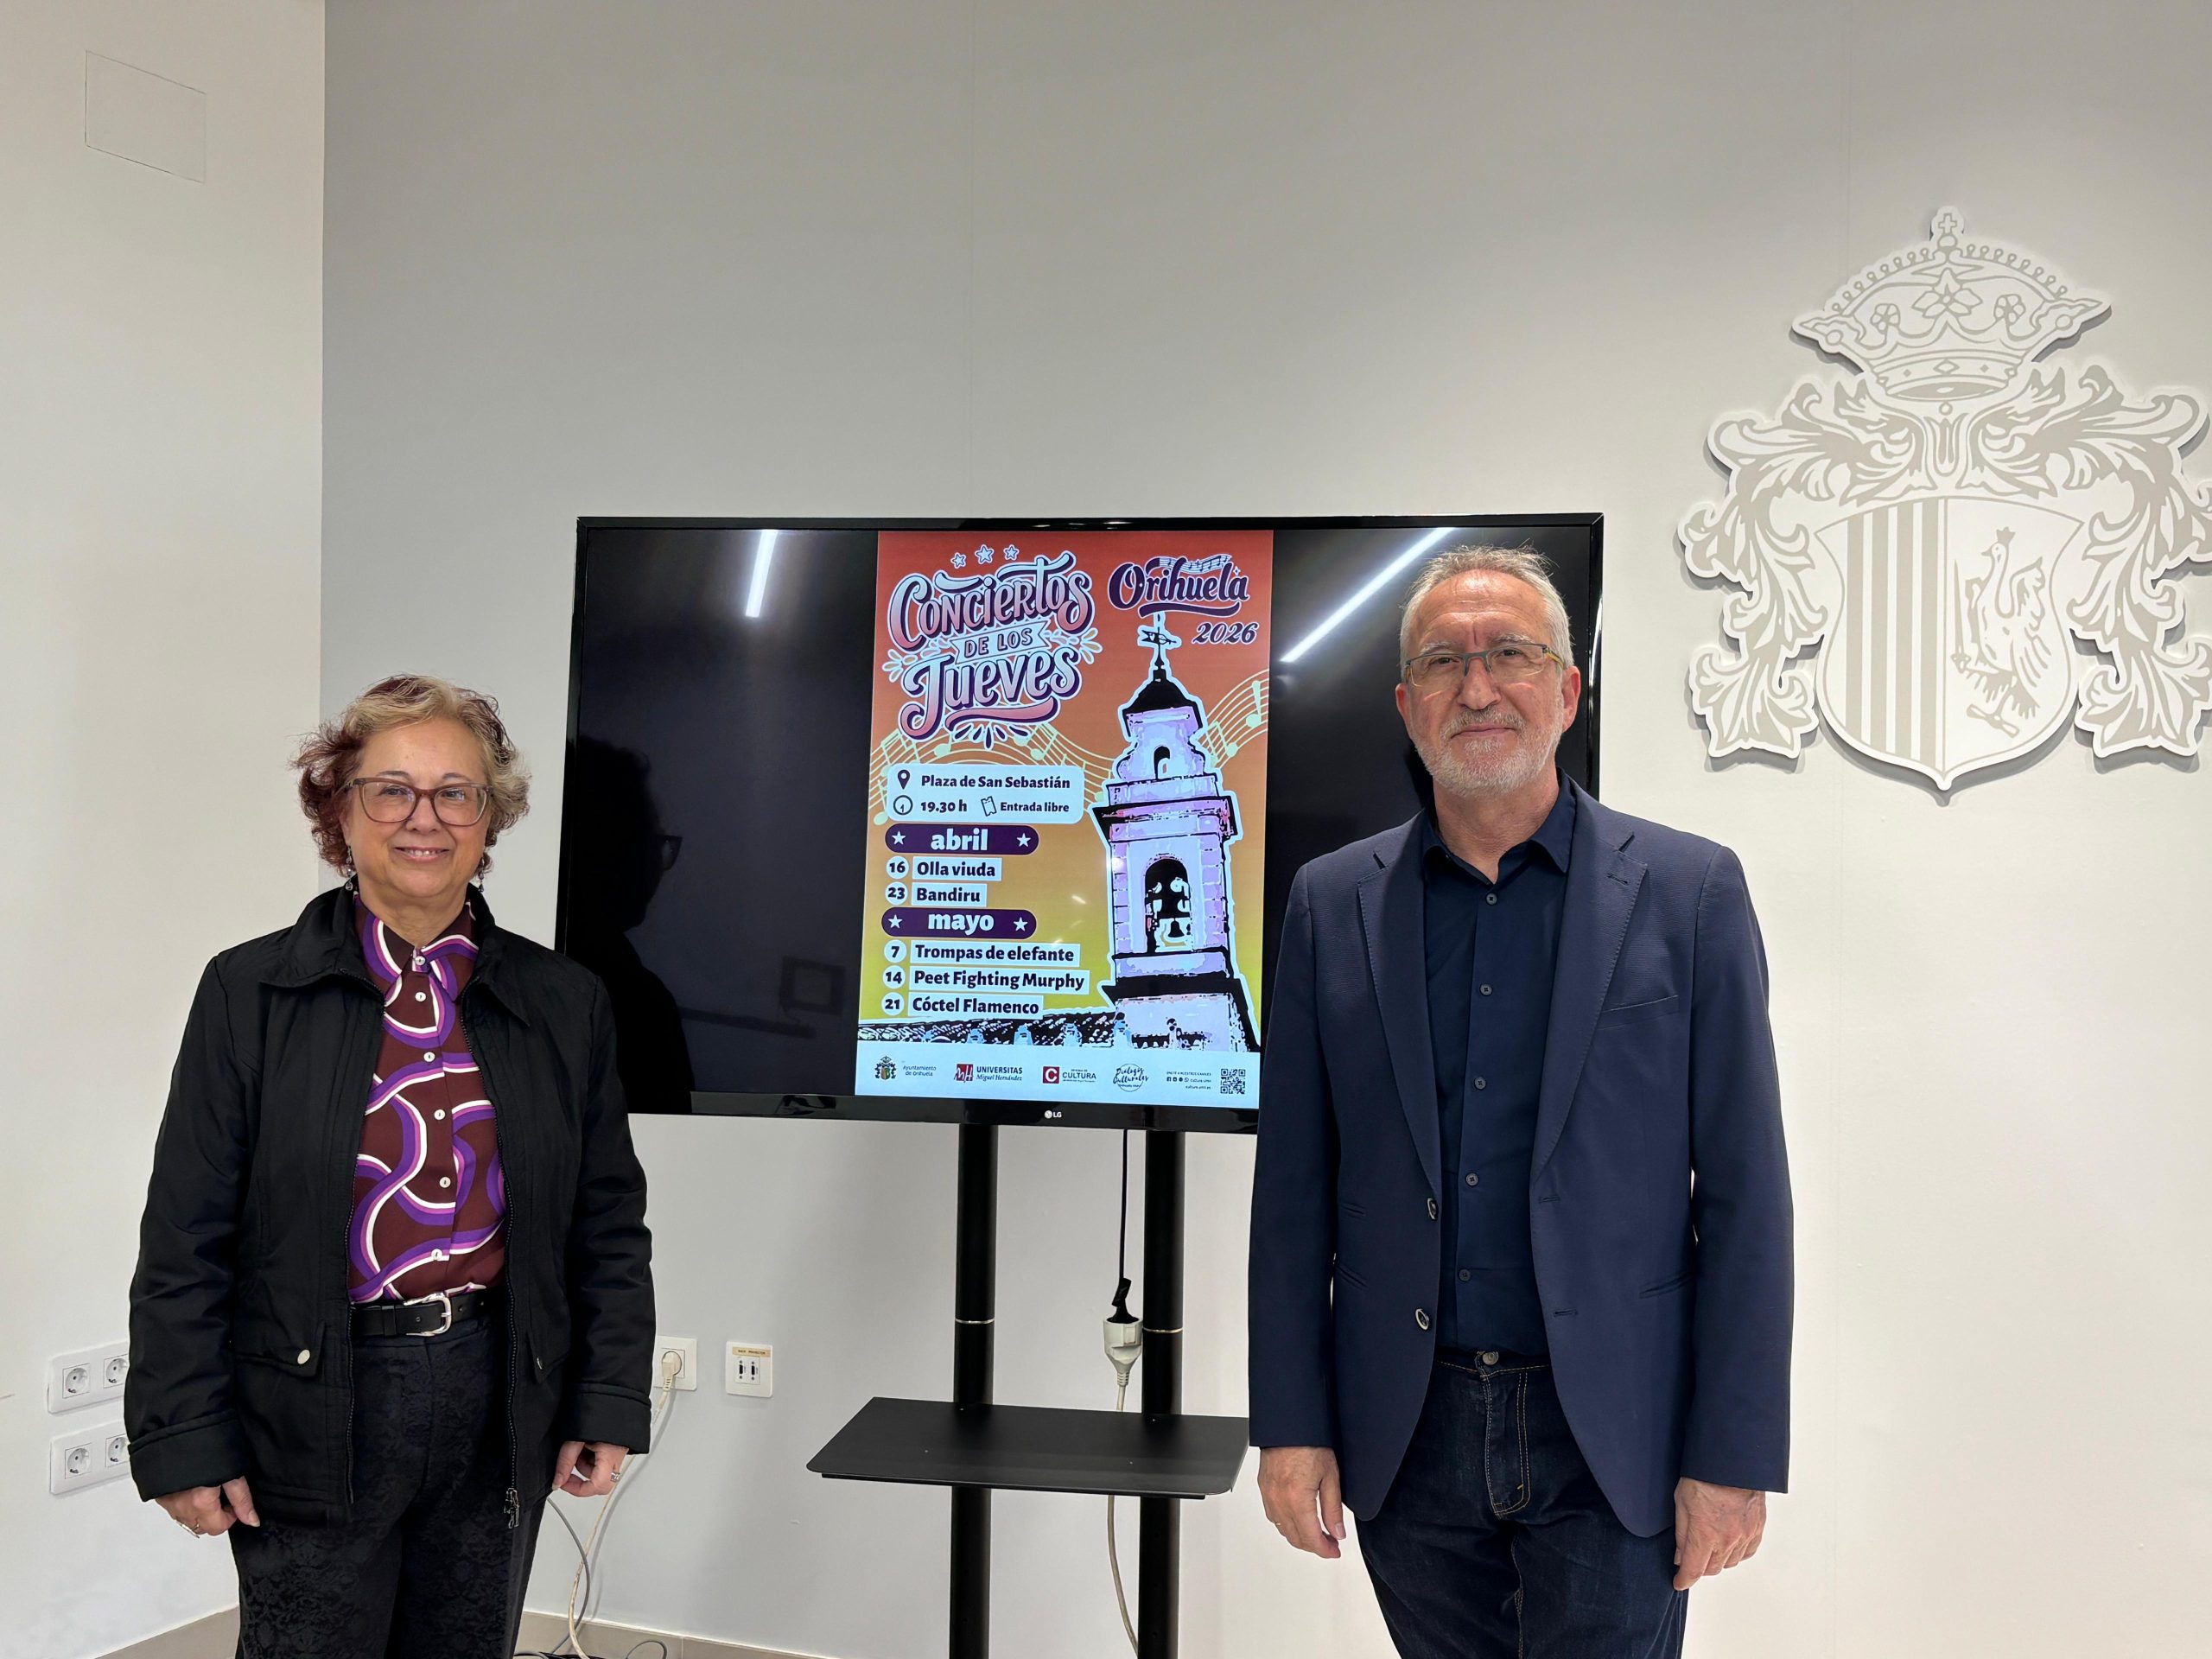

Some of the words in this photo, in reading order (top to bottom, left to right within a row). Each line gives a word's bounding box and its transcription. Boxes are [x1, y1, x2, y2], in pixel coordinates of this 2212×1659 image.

[1109, 556, 1249, 609] Orihuela
[1192, 622, 1259, 645] 2026
[963, 637, 989, 658] DE
[997, 628, 1033, 652] LOS
[921, 775, 957, 787] Plaza
[960, 776, 976, 787] de
[978, 777, 1002, 788] San
[1005, 775, 1071, 789] Sebastián
[921, 801, 956, 813] 19.30
[958, 799, 968, 812] h
[1001, 801, 1043, 812] Entrada
[1044, 801, 1070, 813] libre
[931, 827, 988, 851] abril
[889, 861, 906, 874] 16
[917, 861, 949, 876] Olla
[952, 862, 995, 877] viuda
[887, 887, 906, 899] 23
[917, 887, 981, 902] Bandiru
[928, 913, 995, 936] mayo
[891, 946, 900, 958] 7
[915, 944, 982, 962] Trompas
[985, 945, 1005, 960] de
[1007, 946, 1074, 962] elefante
[886, 971, 903, 984] 14
[914, 970, 950, 985] Peet
[953, 970, 1020, 989] Fighting
[1022, 973, 1085, 991] Murphy
[885, 998, 900, 1010] 21
[912, 995, 959, 1013] Cóctel
[963, 998, 1039, 1014] Flamenco
[976, 1065, 1023, 1075] UNIVERSITAS
